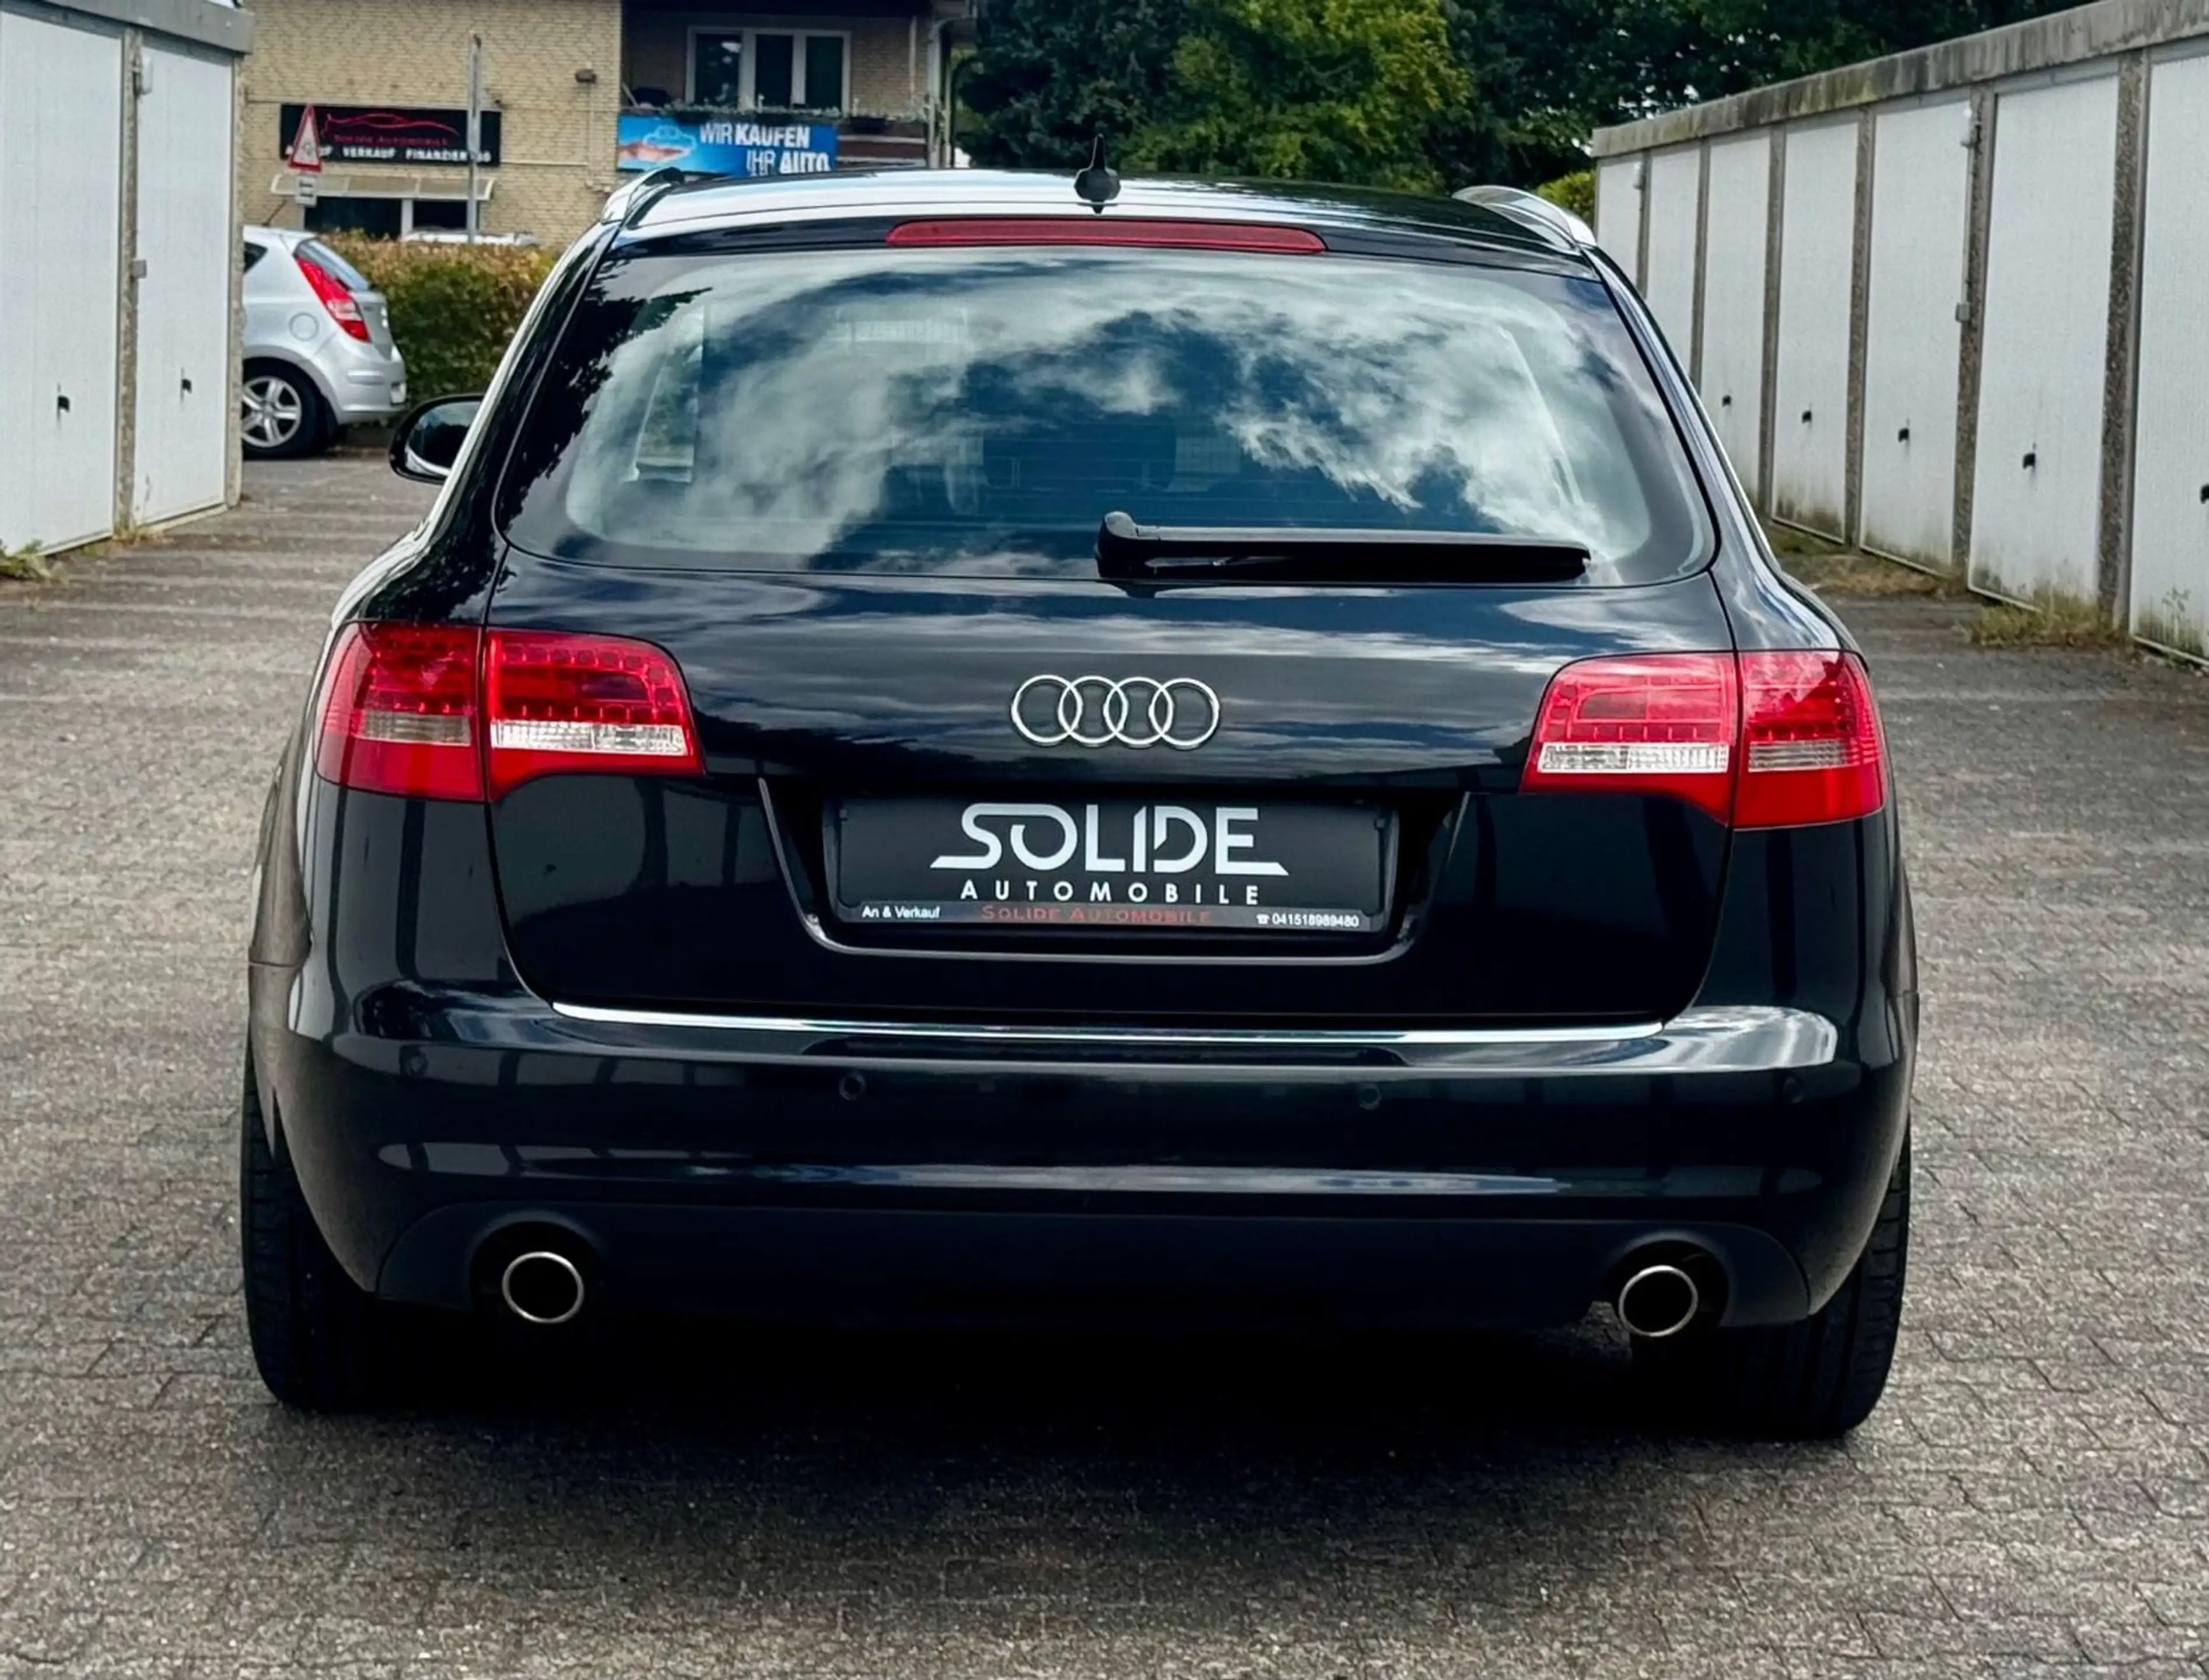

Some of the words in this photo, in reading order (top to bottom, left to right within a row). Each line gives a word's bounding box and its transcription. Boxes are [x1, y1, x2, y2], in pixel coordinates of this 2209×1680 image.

[700, 123, 733, 145] WIR
[735, 124, 810, 148] KAUFEN
[342, 146, 396, 159] VERKAUF
[746, 149, 776, 176] IHR
[779, 150, 831, 174] AUTO
[930, 803, 1289, 876] SOLIDE
[960, 879, 1258, 905] AUTOMOBILE
[862, 906, 879, 918] An
[882, 907, 891, 918] &
[894, 906, 941, 919] Verkauf
